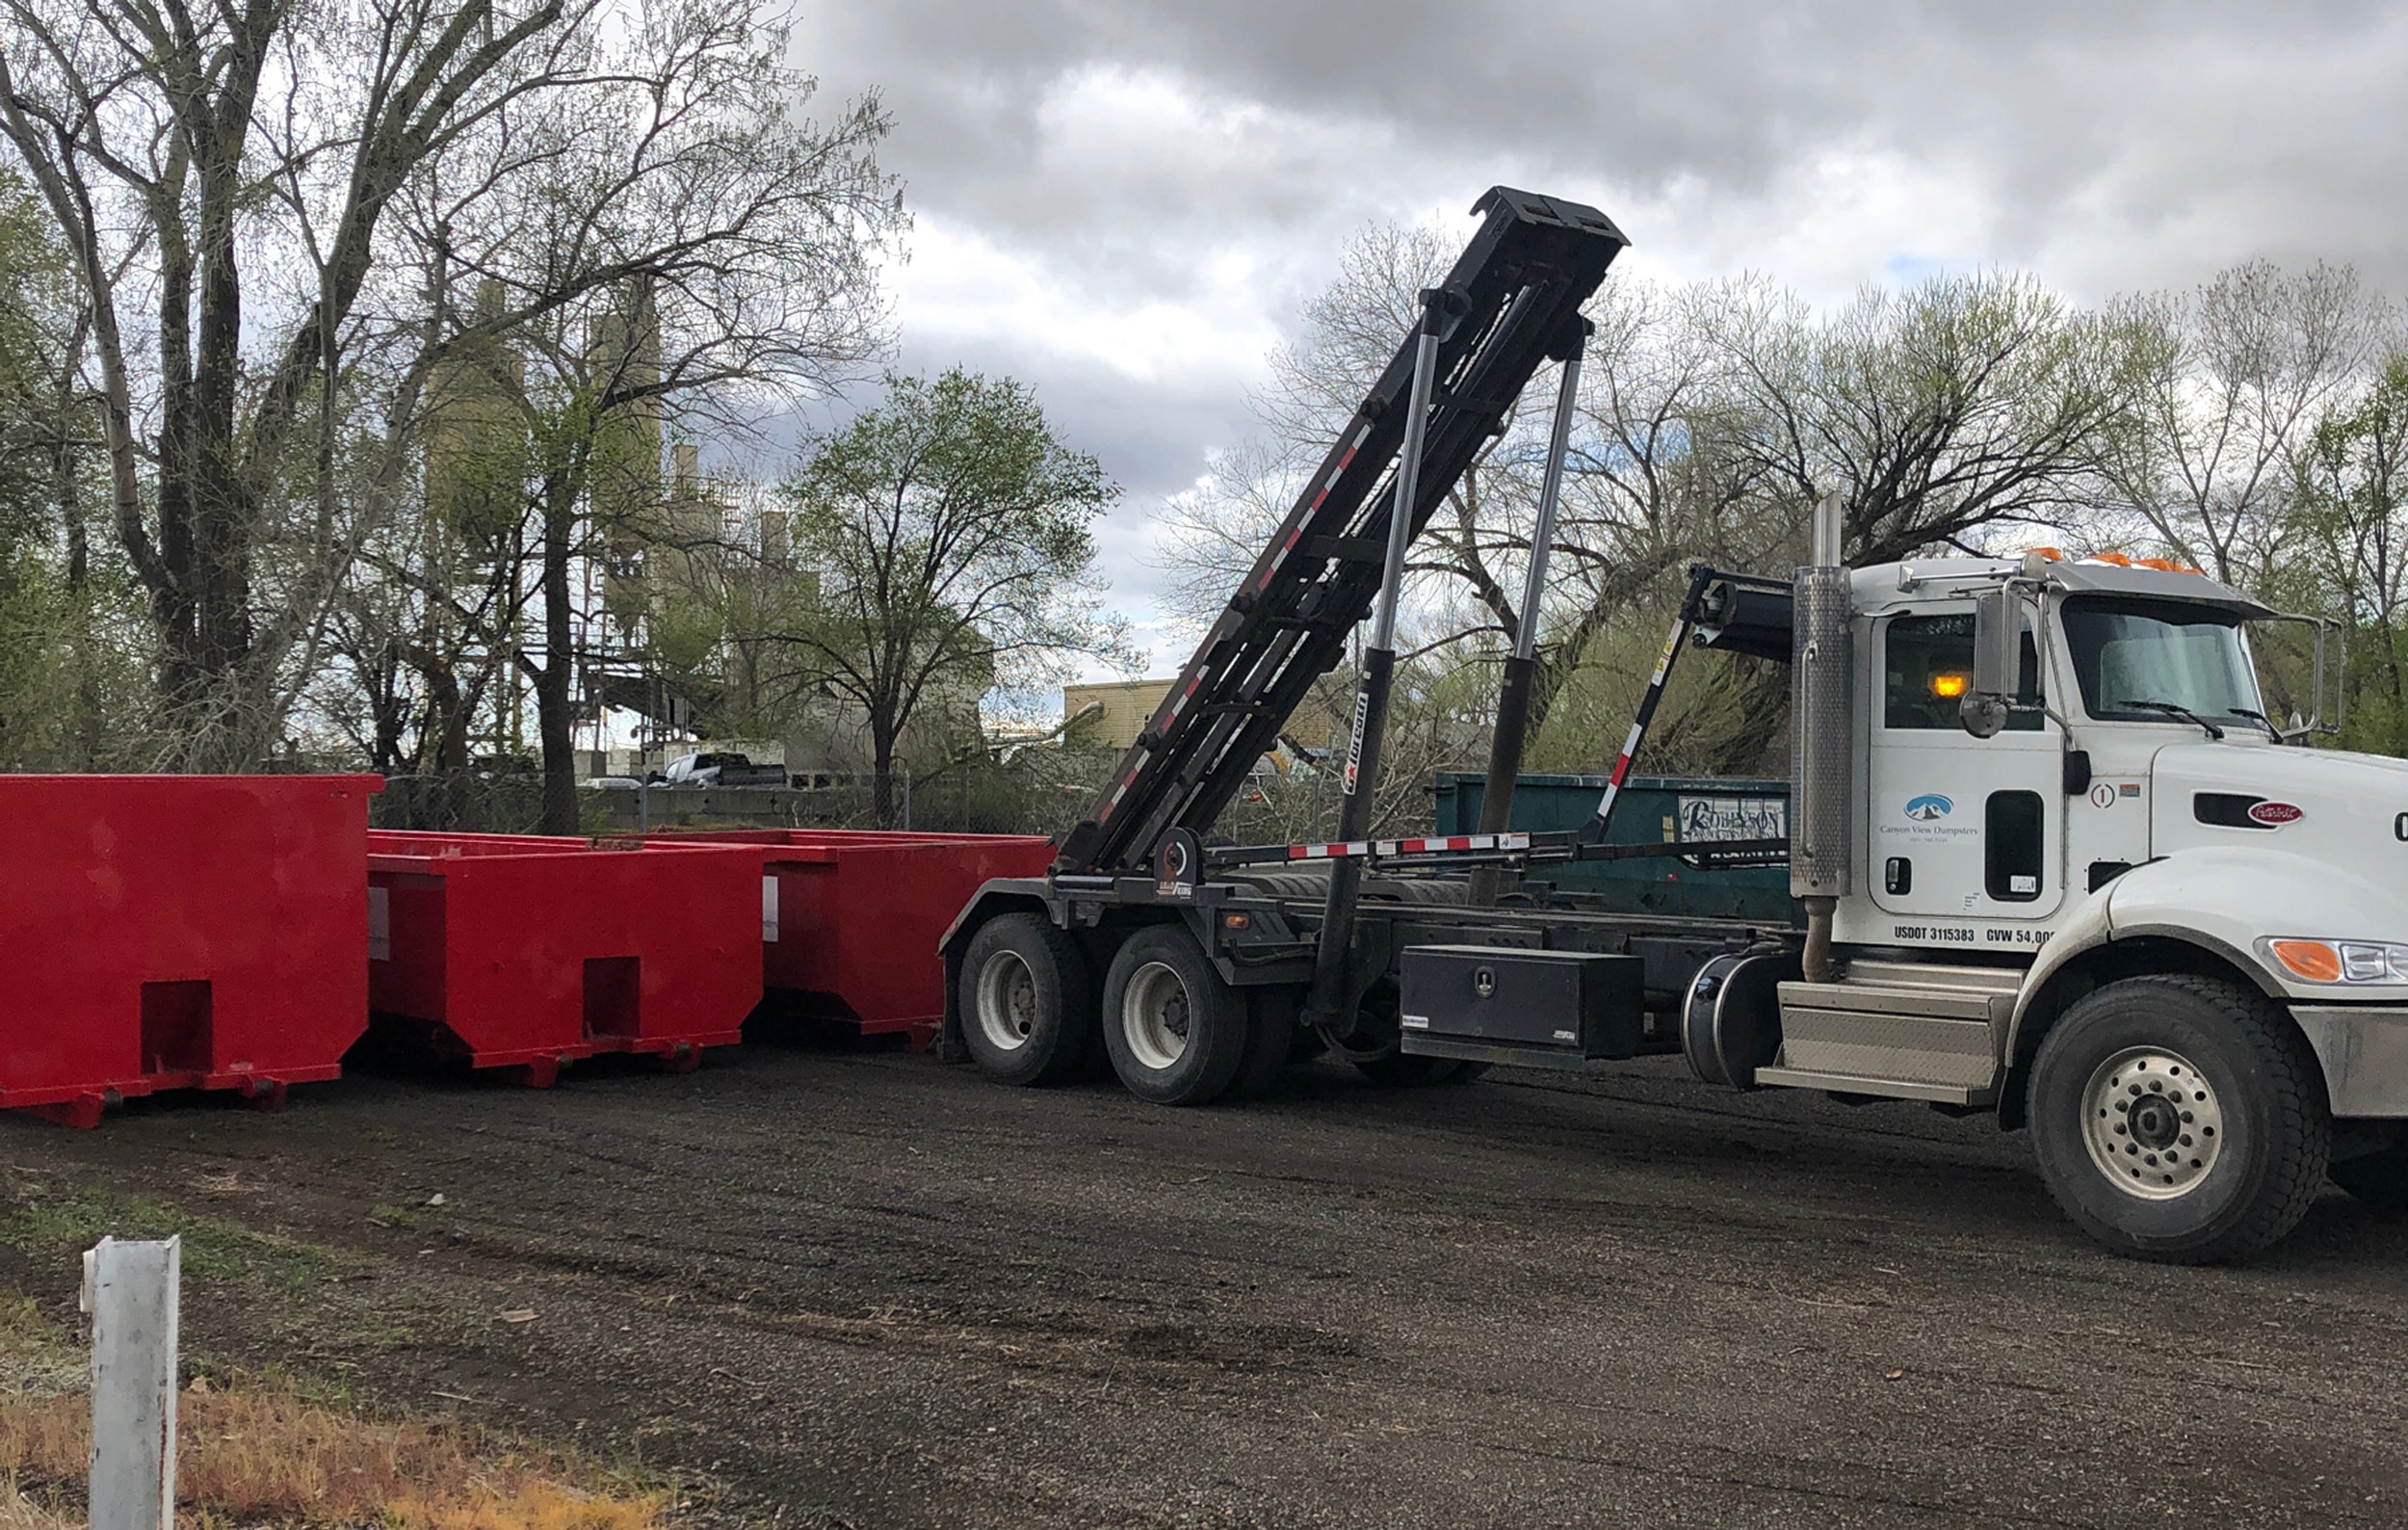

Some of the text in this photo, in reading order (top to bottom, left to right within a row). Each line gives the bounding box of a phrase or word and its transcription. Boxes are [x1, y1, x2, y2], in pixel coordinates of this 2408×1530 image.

[1880, 825, 1978, 837] Canyon View Dumpsters
[1894, 926, 1927, 939] USDOT
[1930, 927, 1975, 942] 3115383
[1986, 929, 2013, 942] GVW
